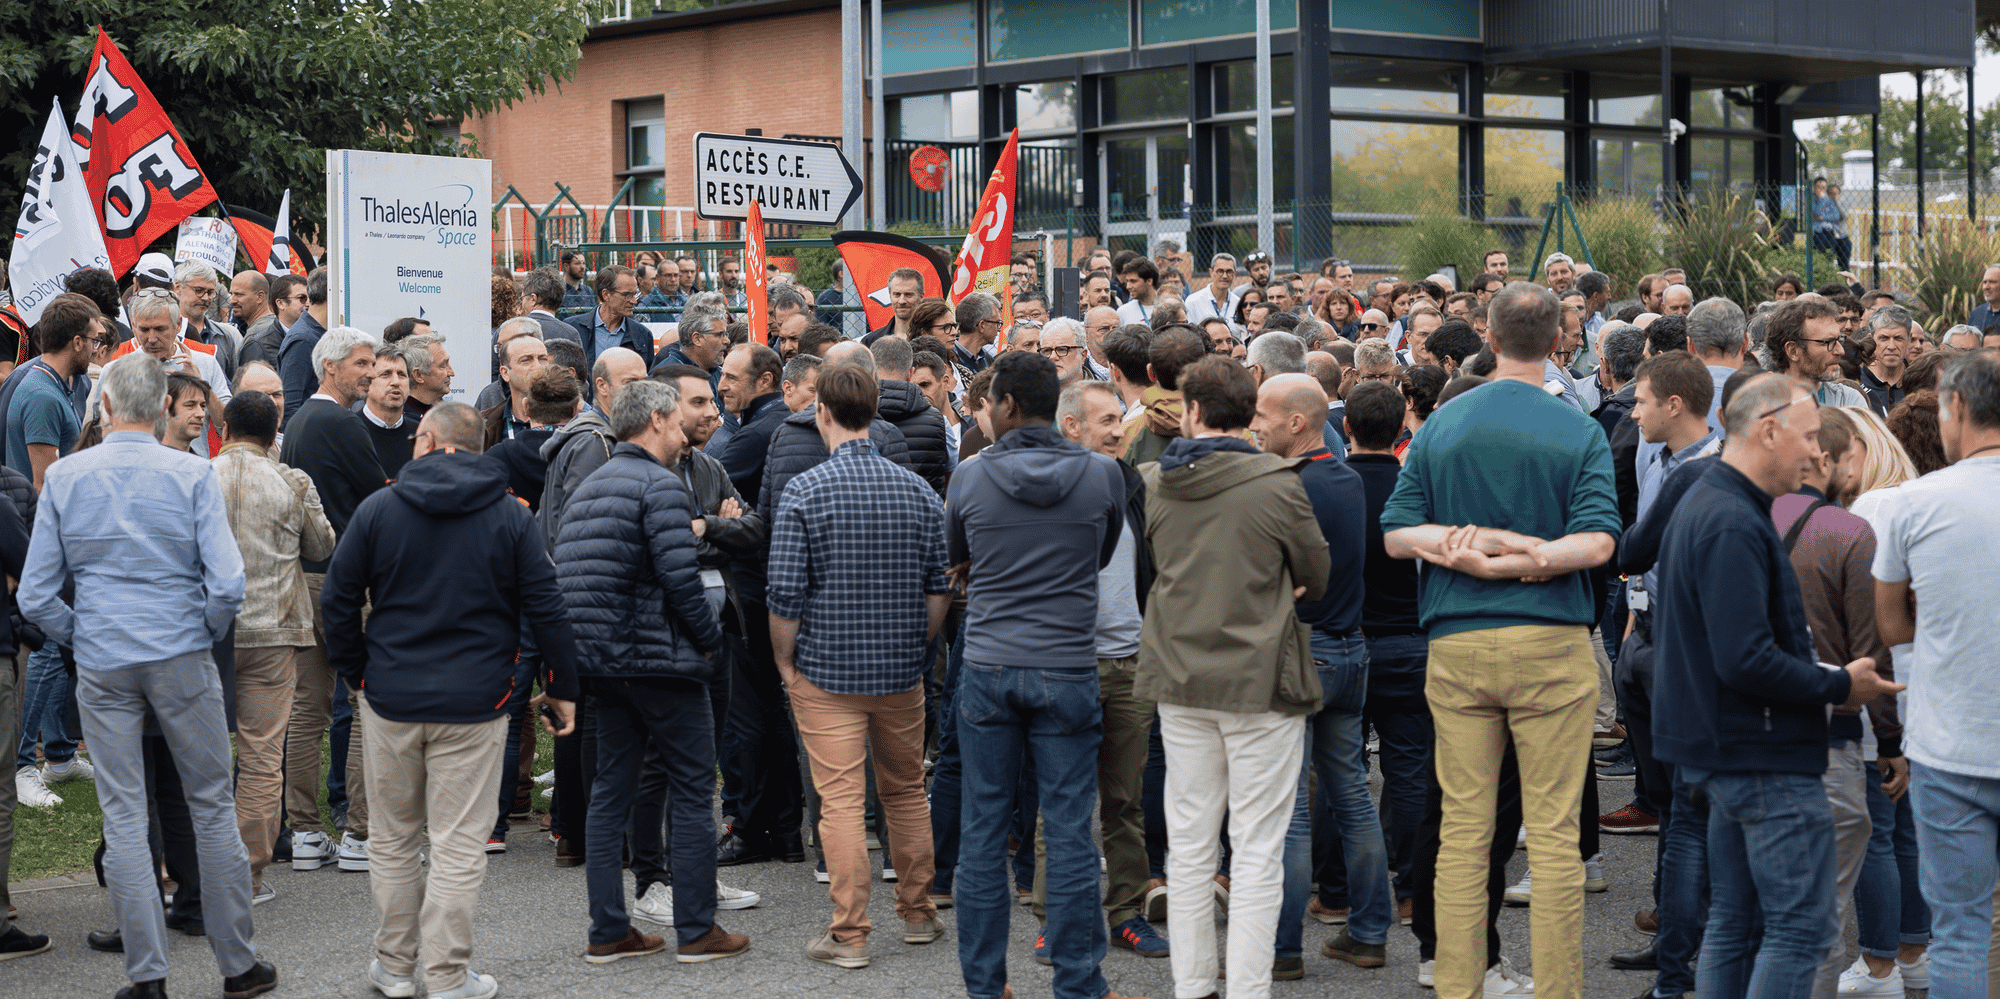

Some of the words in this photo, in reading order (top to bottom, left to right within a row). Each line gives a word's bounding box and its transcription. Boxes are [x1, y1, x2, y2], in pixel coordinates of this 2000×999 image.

[706, 146, 769, 176] ACCÈS
[777, 154, 810, 179] C.E.
[706, 181, 831, 212] RESTAURANT
[360, 197, 477, 227] ThalesAlenia
[209, 219, 223, 233] FO
[185, 240, 215, 250] ALENIA
[437, 227, 477, 248] Space
[191, 251, 227, 269] TOULOUSE
[397, 266, 444, 279] Bienvenue
[398, 281, 442, 294] Welcome
